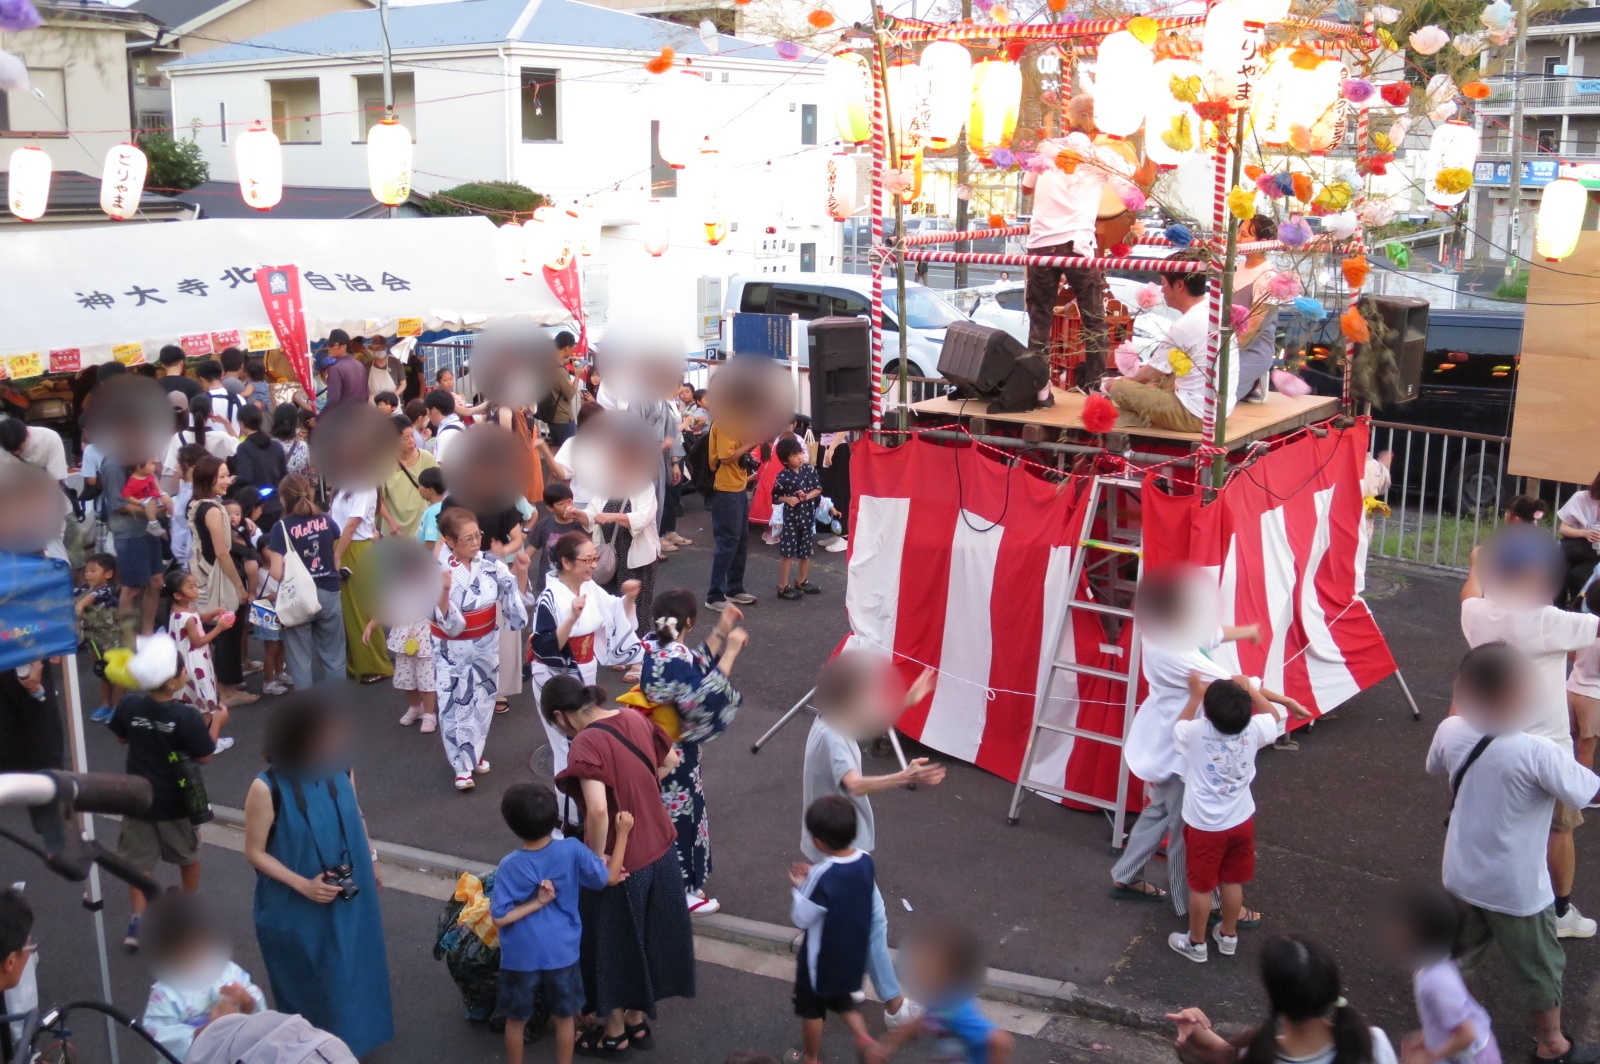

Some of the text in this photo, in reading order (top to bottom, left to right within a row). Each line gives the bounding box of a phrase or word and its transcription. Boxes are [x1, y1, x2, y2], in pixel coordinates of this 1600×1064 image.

[112, 153, 131, 209] とりやま
[75, 265, 412, 310] 神大寺北自治会
